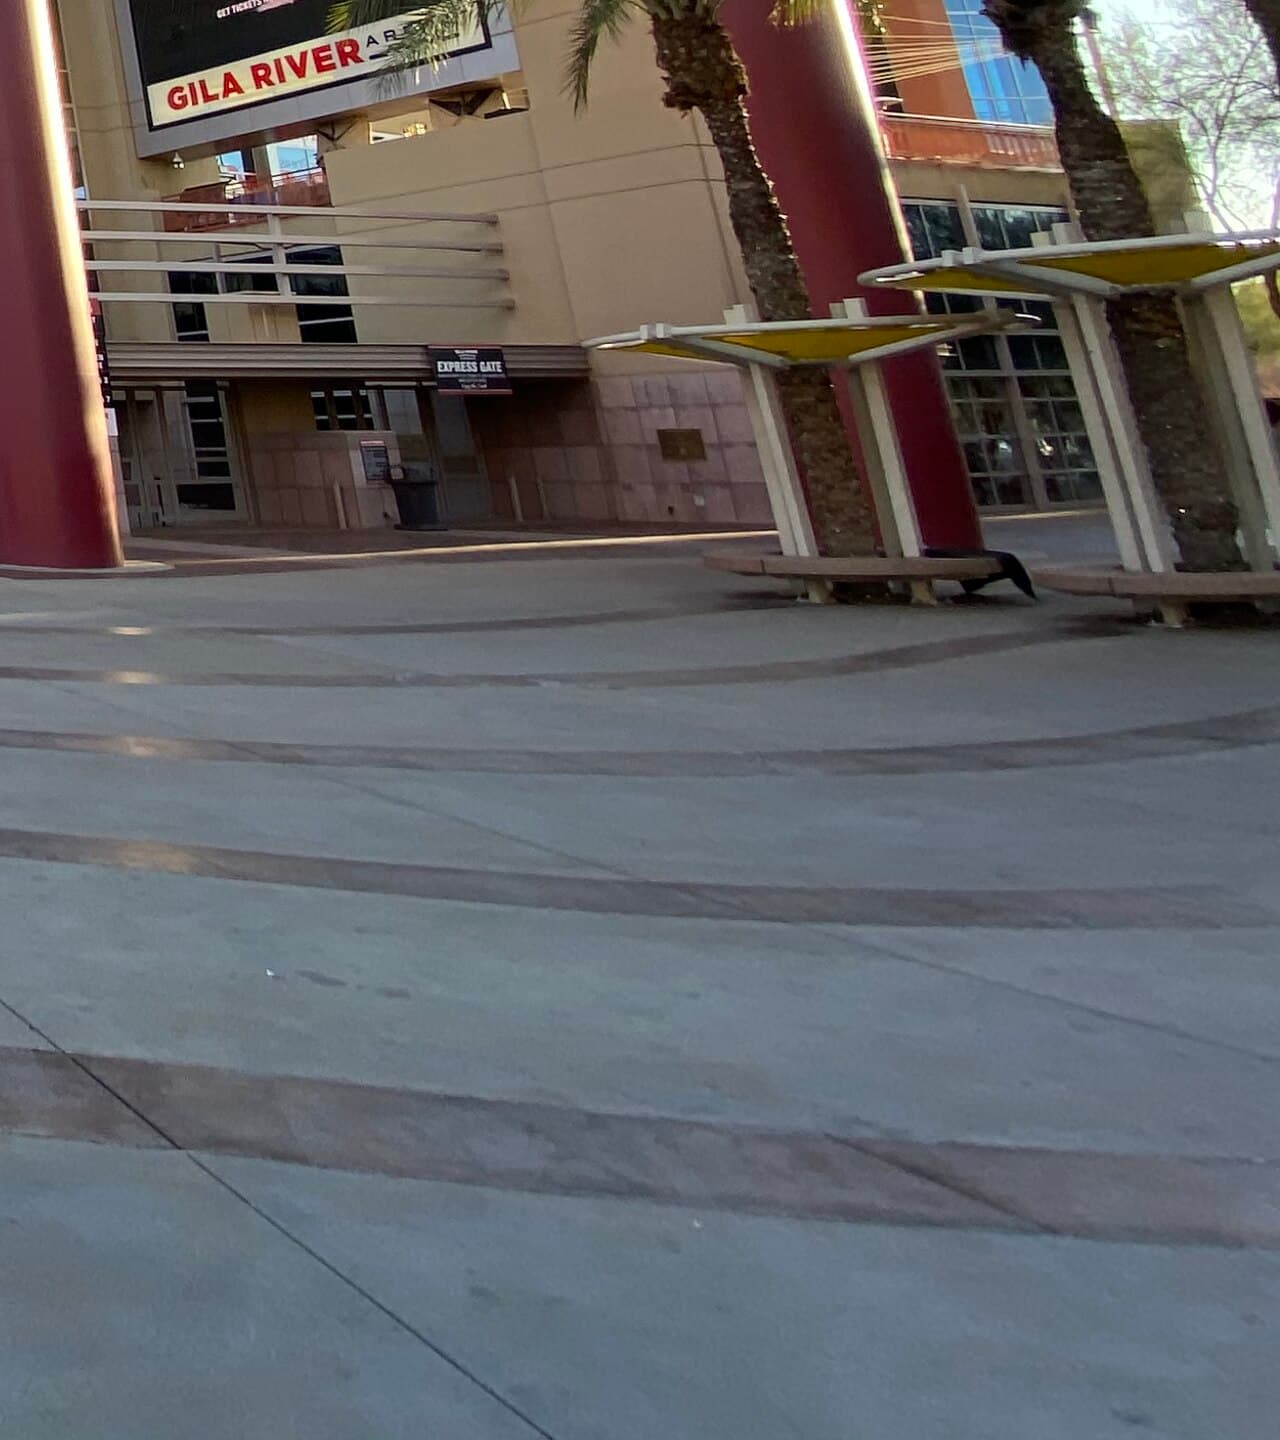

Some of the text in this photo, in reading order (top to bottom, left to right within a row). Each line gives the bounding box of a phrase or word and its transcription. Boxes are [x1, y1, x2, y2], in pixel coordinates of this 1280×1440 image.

[216, 4, 231, 18] GET
[167, 37, 365, 111] GILA RIVER
[436, 361, 503, 372] EXPRESS GATE
